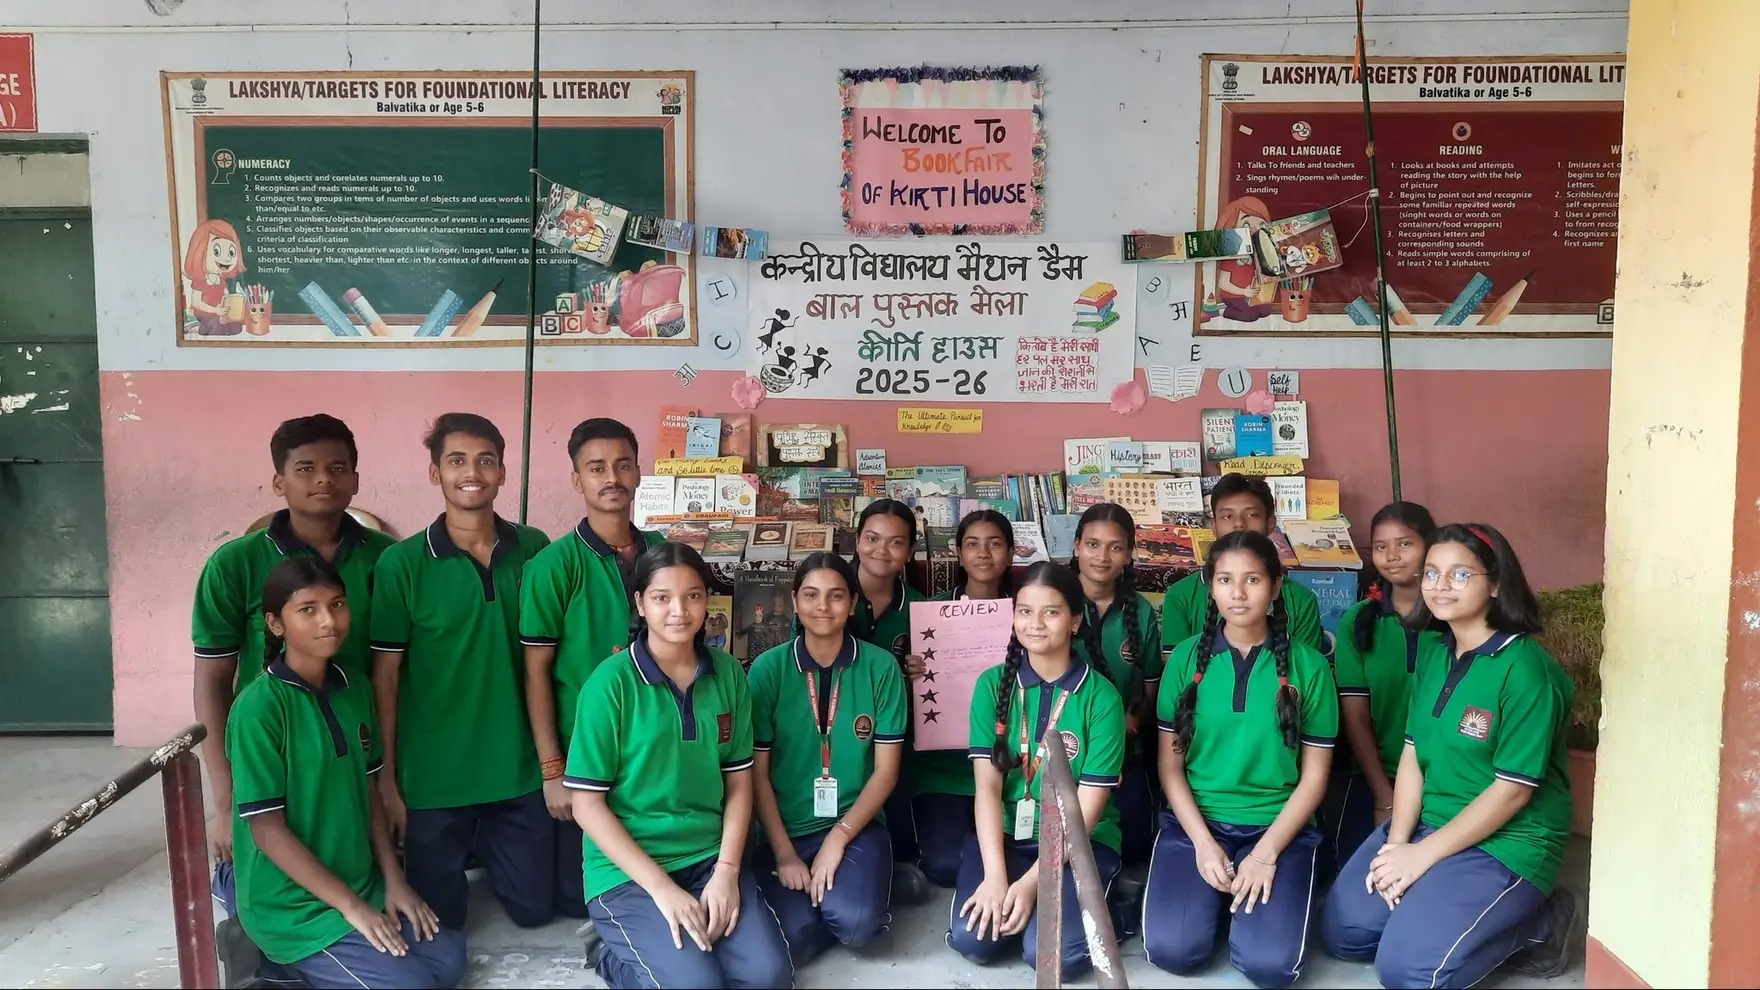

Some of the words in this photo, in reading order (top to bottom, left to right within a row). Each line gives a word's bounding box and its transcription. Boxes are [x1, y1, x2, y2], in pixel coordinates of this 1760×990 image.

[1423, 65, 1456, 84] FOR
[1463, 65, 1592, 83] FOUNDATIONAL
[1599, 65, 1624, 82] LIT
[229, 80, 378, 100] LAKSHYA/TARGETS
[384, 80, 416, 98] FOR
[553, 81, 630, 99] LITERACY
[1419, 87, 1470, 97] Balvatika
[1474, 89, 1485, 97] or
[1488, 86, 1508, 100] Age
[1512, 86, 1531, 97] 5-6
[376, 101, 426, 112] Balvatika
[429, 104, 440, 112] or
[443, 102, 462, 114] Age
[466, 101, 484, 112] 5-6
[863, 116, 962, 144] WELCOME
[1262, 146, 1287, 155] ORAL
[1290, 145, 1341, 155] LANGUAGE
[1439, 145, 1482, 154] READING
[238, 159, 290, 168] NUMERACY
[1478, 162, 1514, 170] attempts
[254, 173, 282, 181] Counts
[284, 173, 312, 183] objects
[1400, 171, 1430, 180] reading
[1447, 172, 1467, 180] story
[1504, 171, 1521, 180] help
[254, 184, 299, 193] Recognizes
[342, 184, 379, 192] numerals
[1245, 186, 1278, 195] standing
[1410, 181, 1438, 190] picture
[890, 179, 955, 211] KIRTI
[963, 178, 1027, 207] HOUSE
[1422, 249, 1448, 258] simple
[1476, 249, 1520, 258] comprising
[956, 242, 1032, 281] मैथन
[1037, 243, 1088, 281] डैम
[1145, 276, 1161, 293] B
[558, 299, 569, 311] A
[806, 293, 864, 320] बाल
[871, 292, 958, 328] पुस्तक
[970, 284, 1029, 316] मेला
[1169, 301, 1188, 321] अ
[545, 318, 557, 332] B
[567, 317, 579, 331] C
[931, 336, 1004, 363] हाउस
[1139, 336, 1159, 356] A
[1190, 344, 1202, 362] E
[1228, 370, 1245, 394] U
[1272, 414, 1300, 424] Money
[1069, 444, 1102, 466] JING
[1163, 480, 1193, 491] भारत
[640, 491, 671, 501] Atomic
[683, 492, 709, 501] Money
[640, 502, 669, 511] Habits
[1311, 588, 1351, 598] NERAL
[940, 601, 999, 618] REVIEW
